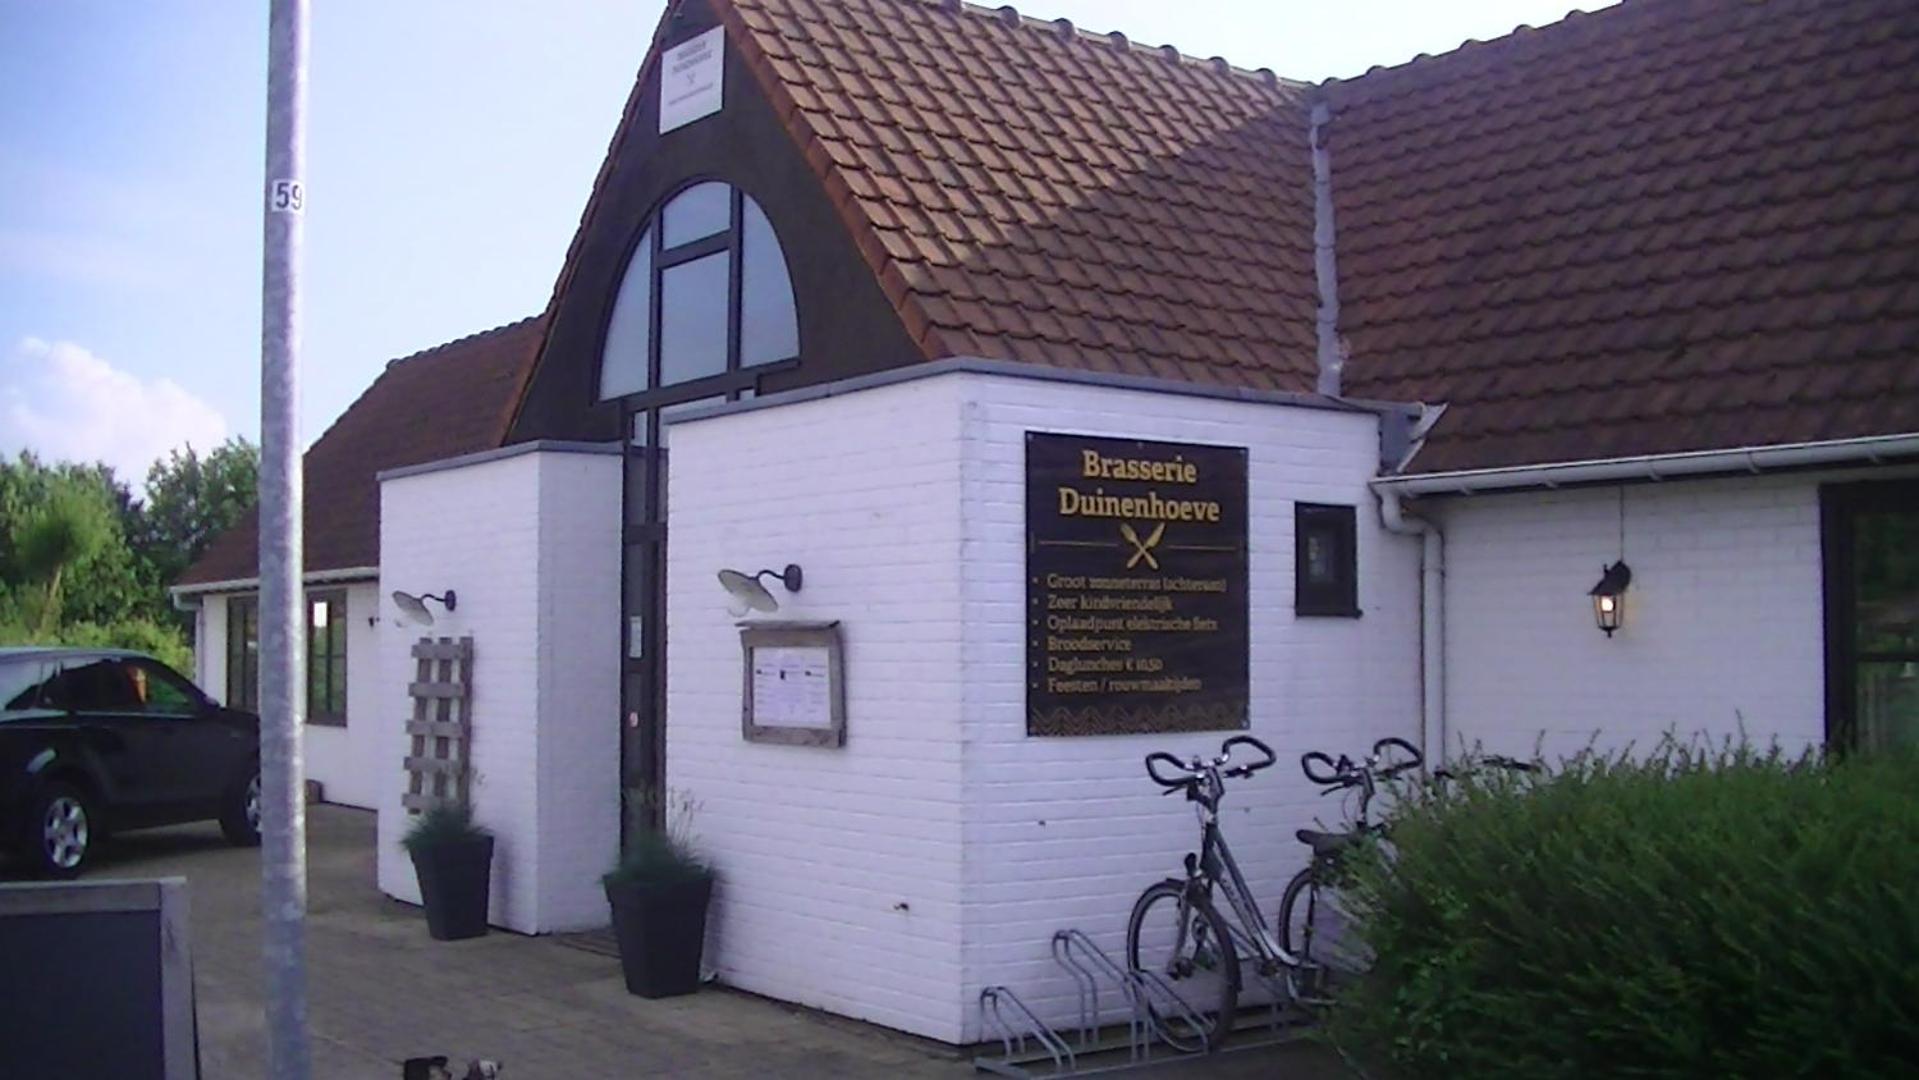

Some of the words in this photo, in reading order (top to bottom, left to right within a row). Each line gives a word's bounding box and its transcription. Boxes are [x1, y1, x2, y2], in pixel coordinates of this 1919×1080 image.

[276, 182, 302, 210] 59
[1082, 449, 1197, 483] Brasserie
[1059, 487, 1220, 521] Duinenhoeve
[1047, 573, 1085, 589] Groot
[1047, 594, 1076, 610] Zeer
[1047, 636, 1132, 651] Broodservice
[1048, 677, 1098, 692] Feesten
